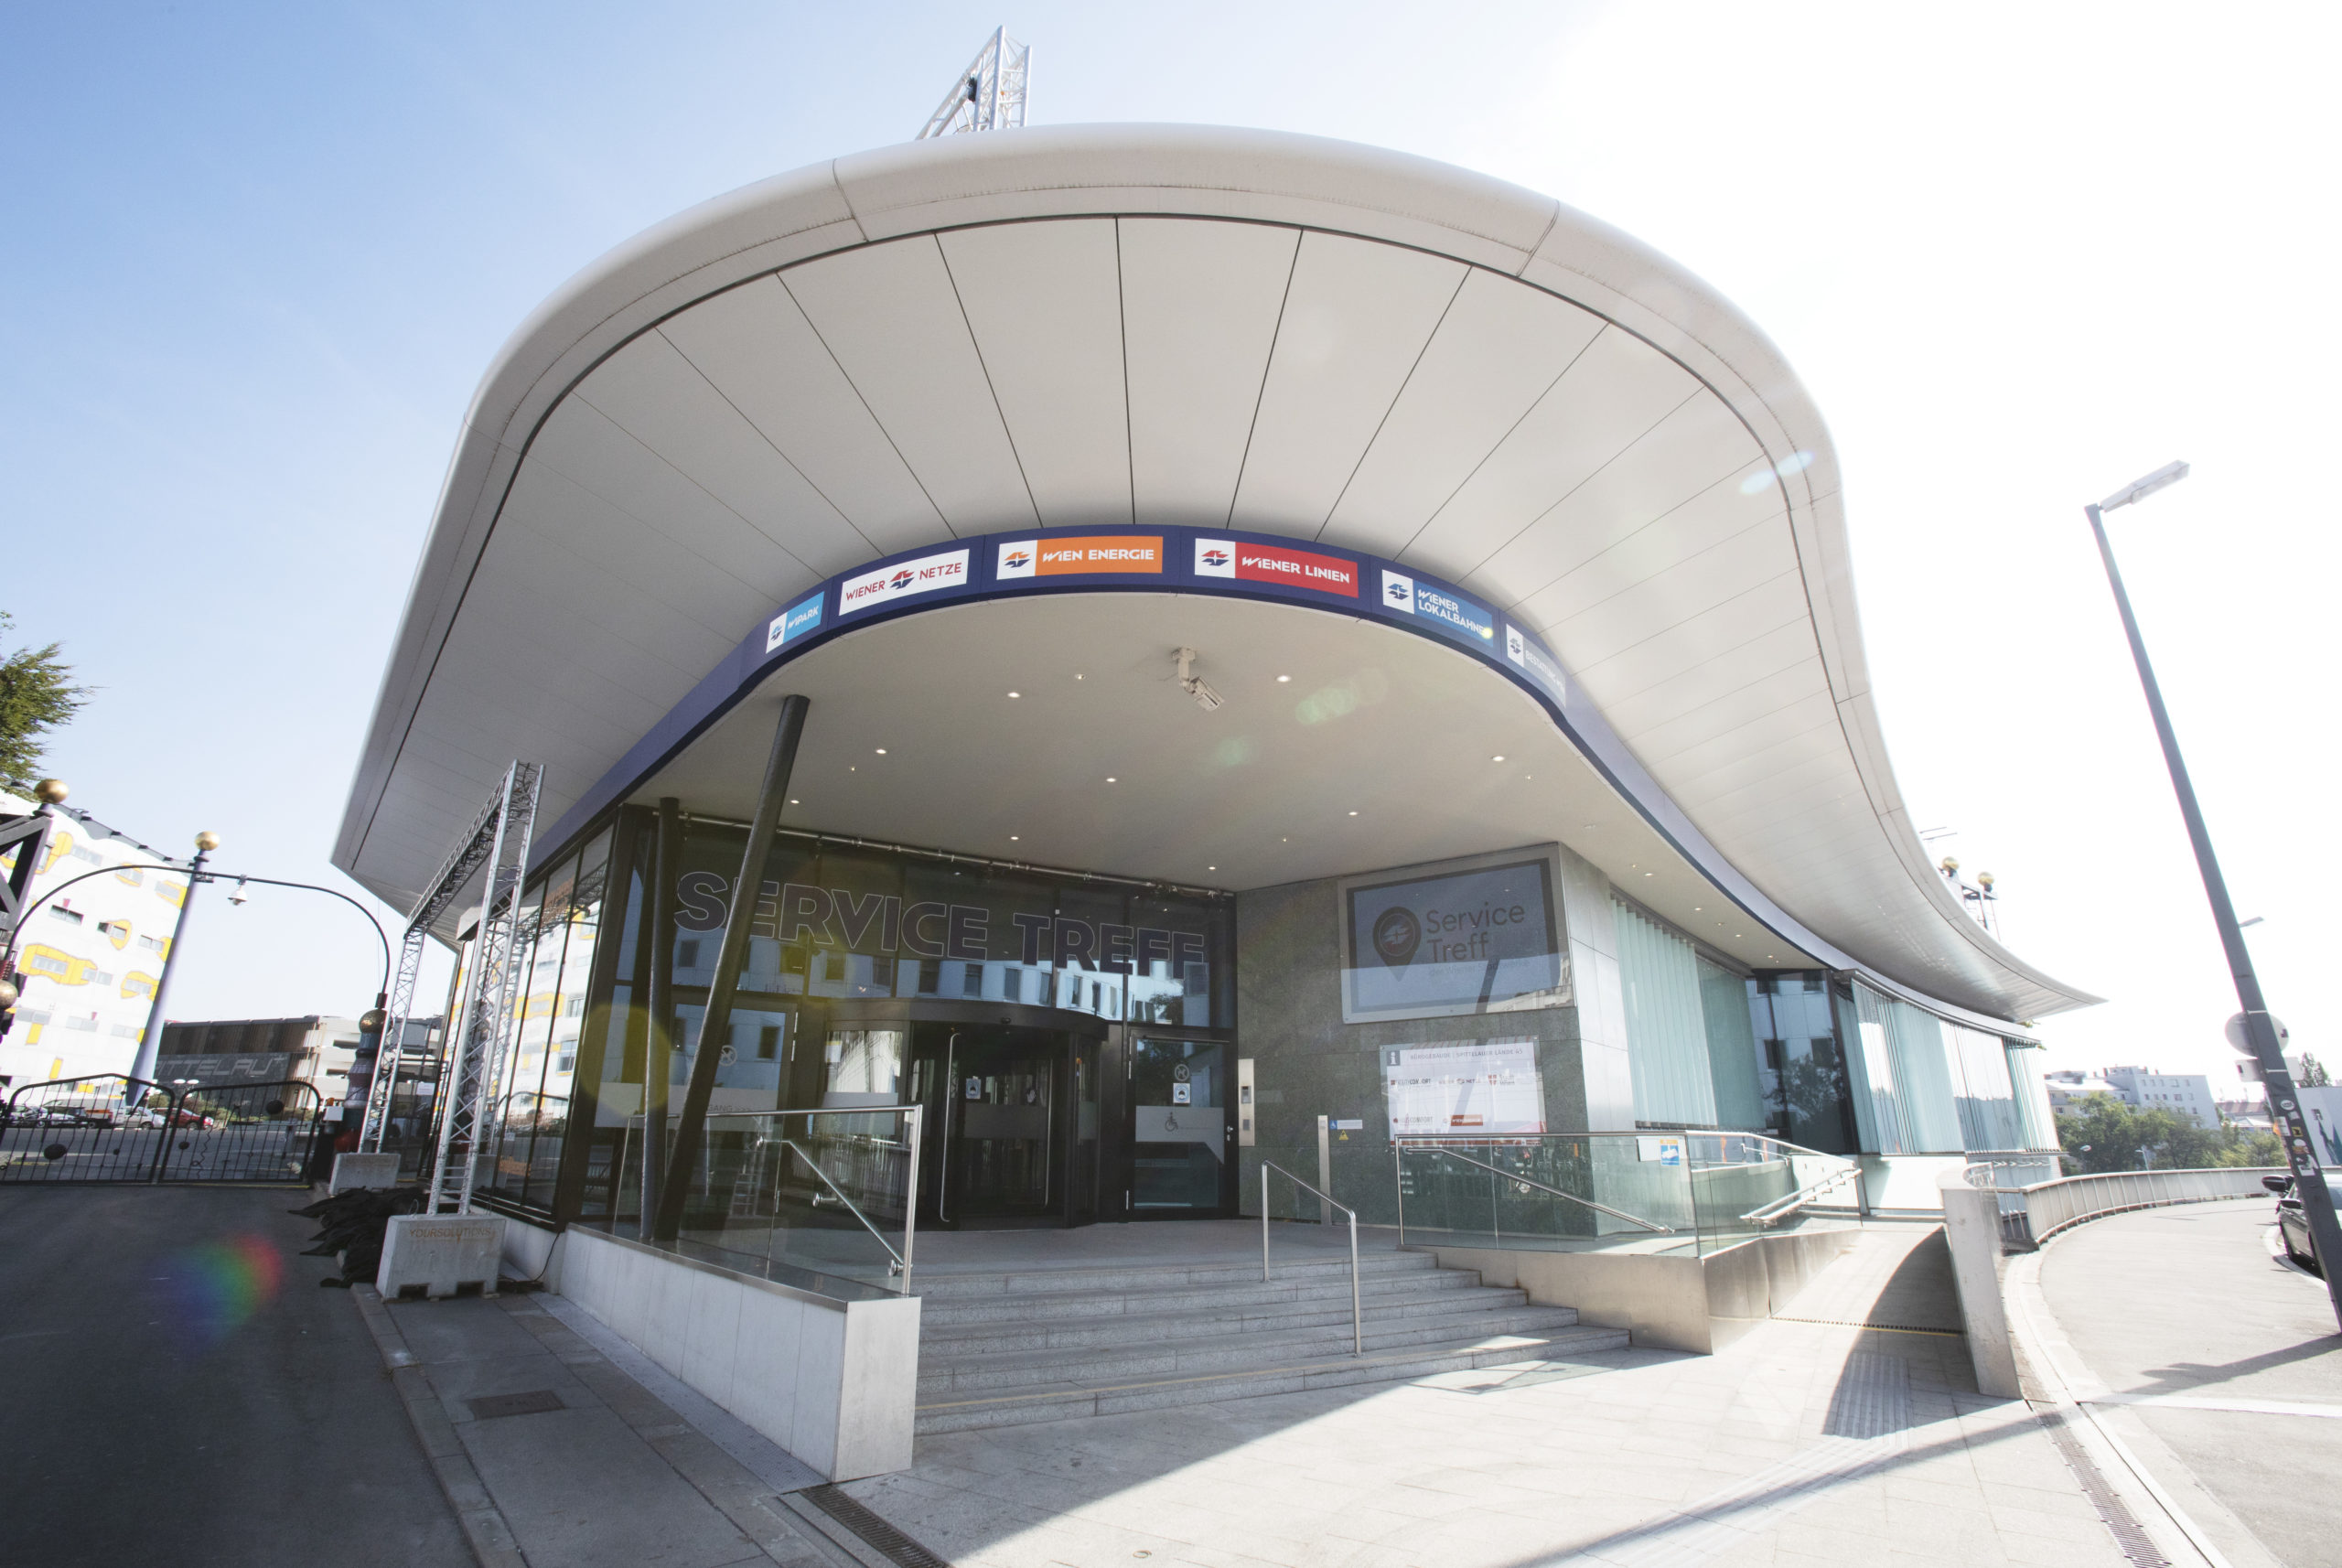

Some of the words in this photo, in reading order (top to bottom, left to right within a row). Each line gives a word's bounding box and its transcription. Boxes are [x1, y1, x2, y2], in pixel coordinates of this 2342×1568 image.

[1042, 550, 1082, 562] WIEN
[1088, 549, 1155, 561] ENERGIE
[1241, 556, 1301, 575] WIENER
[1305, 565, 1350, 584] LINIEN
[846, 580, 886, 601] WIENER
[919, 562, 962, 580] NETZE
[1418, 589, 1459, 613] WIENER
[788, 606, 819, 629] WIPARK
[1419, 599, 1490, 638] LOKALBAHNE
[673, 871, 990, 961] SERVICE
[1013, 913, 1205, 979] TREFF
[1426, 902, 1525, 934] Service
[1427, 931, 1488, 962] Treff
